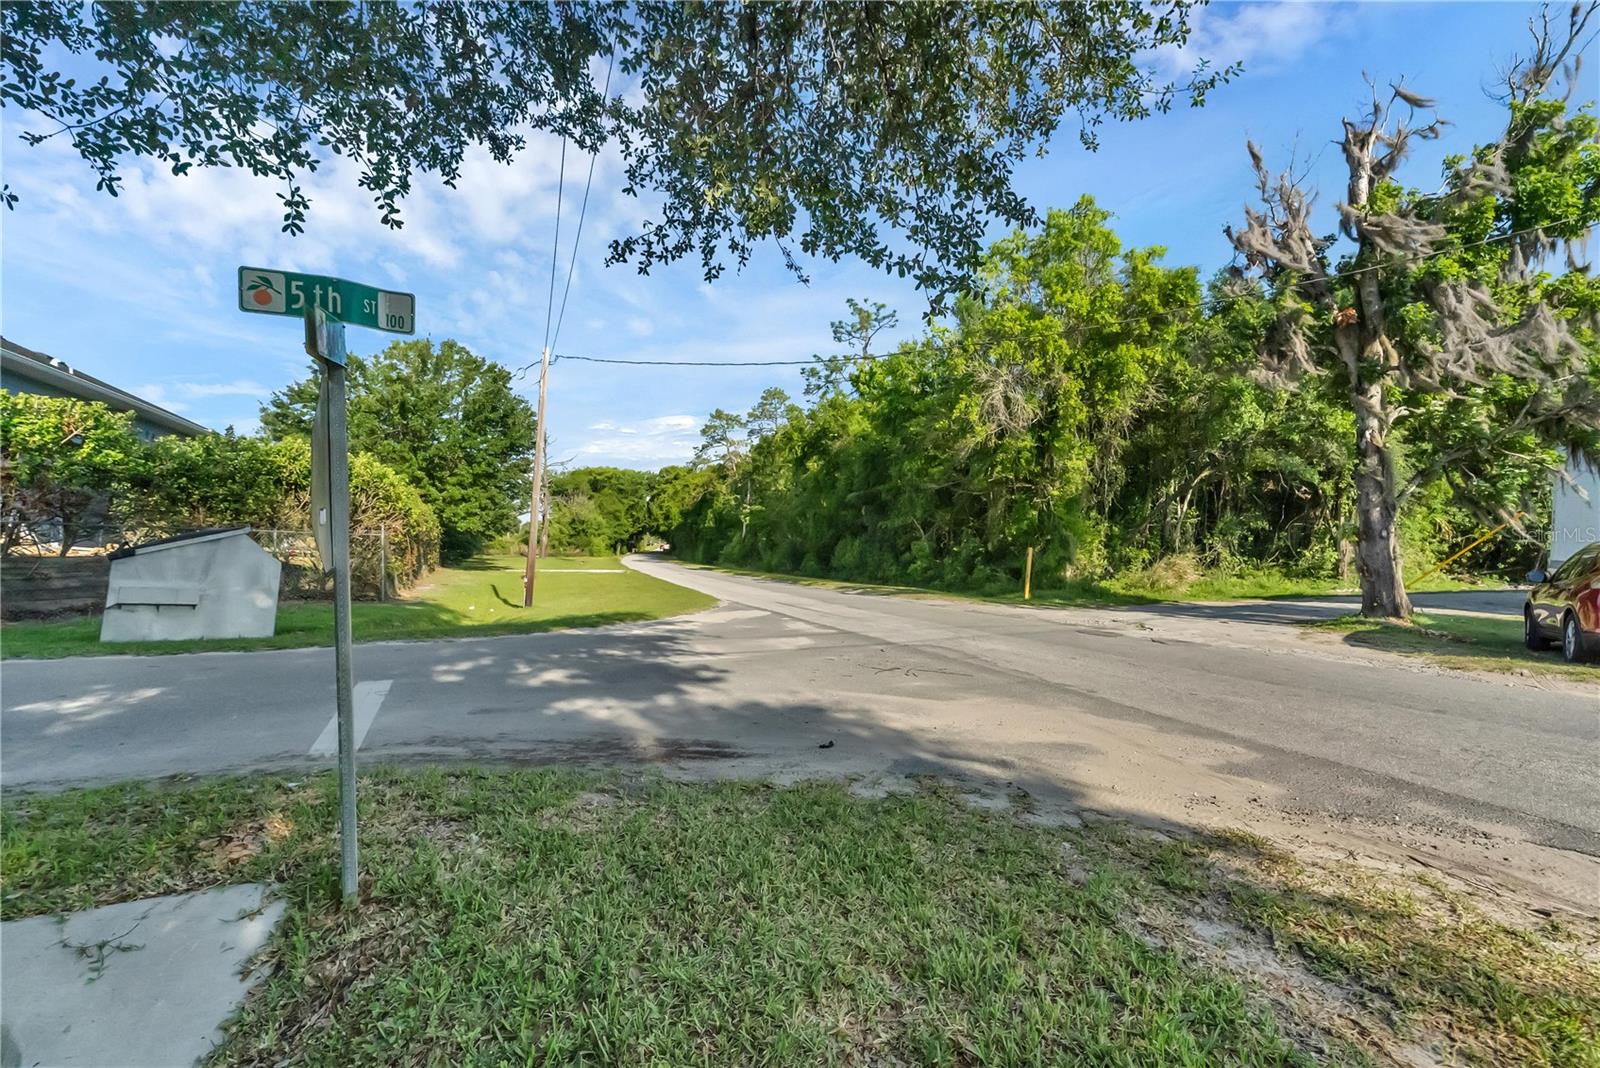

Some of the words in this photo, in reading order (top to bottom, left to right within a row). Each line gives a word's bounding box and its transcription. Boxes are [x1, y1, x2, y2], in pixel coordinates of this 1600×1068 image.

[290, 281, 341, 314] 5th
[364, 299, 376, 315] ST
[386, 313, 405, 330] 100
